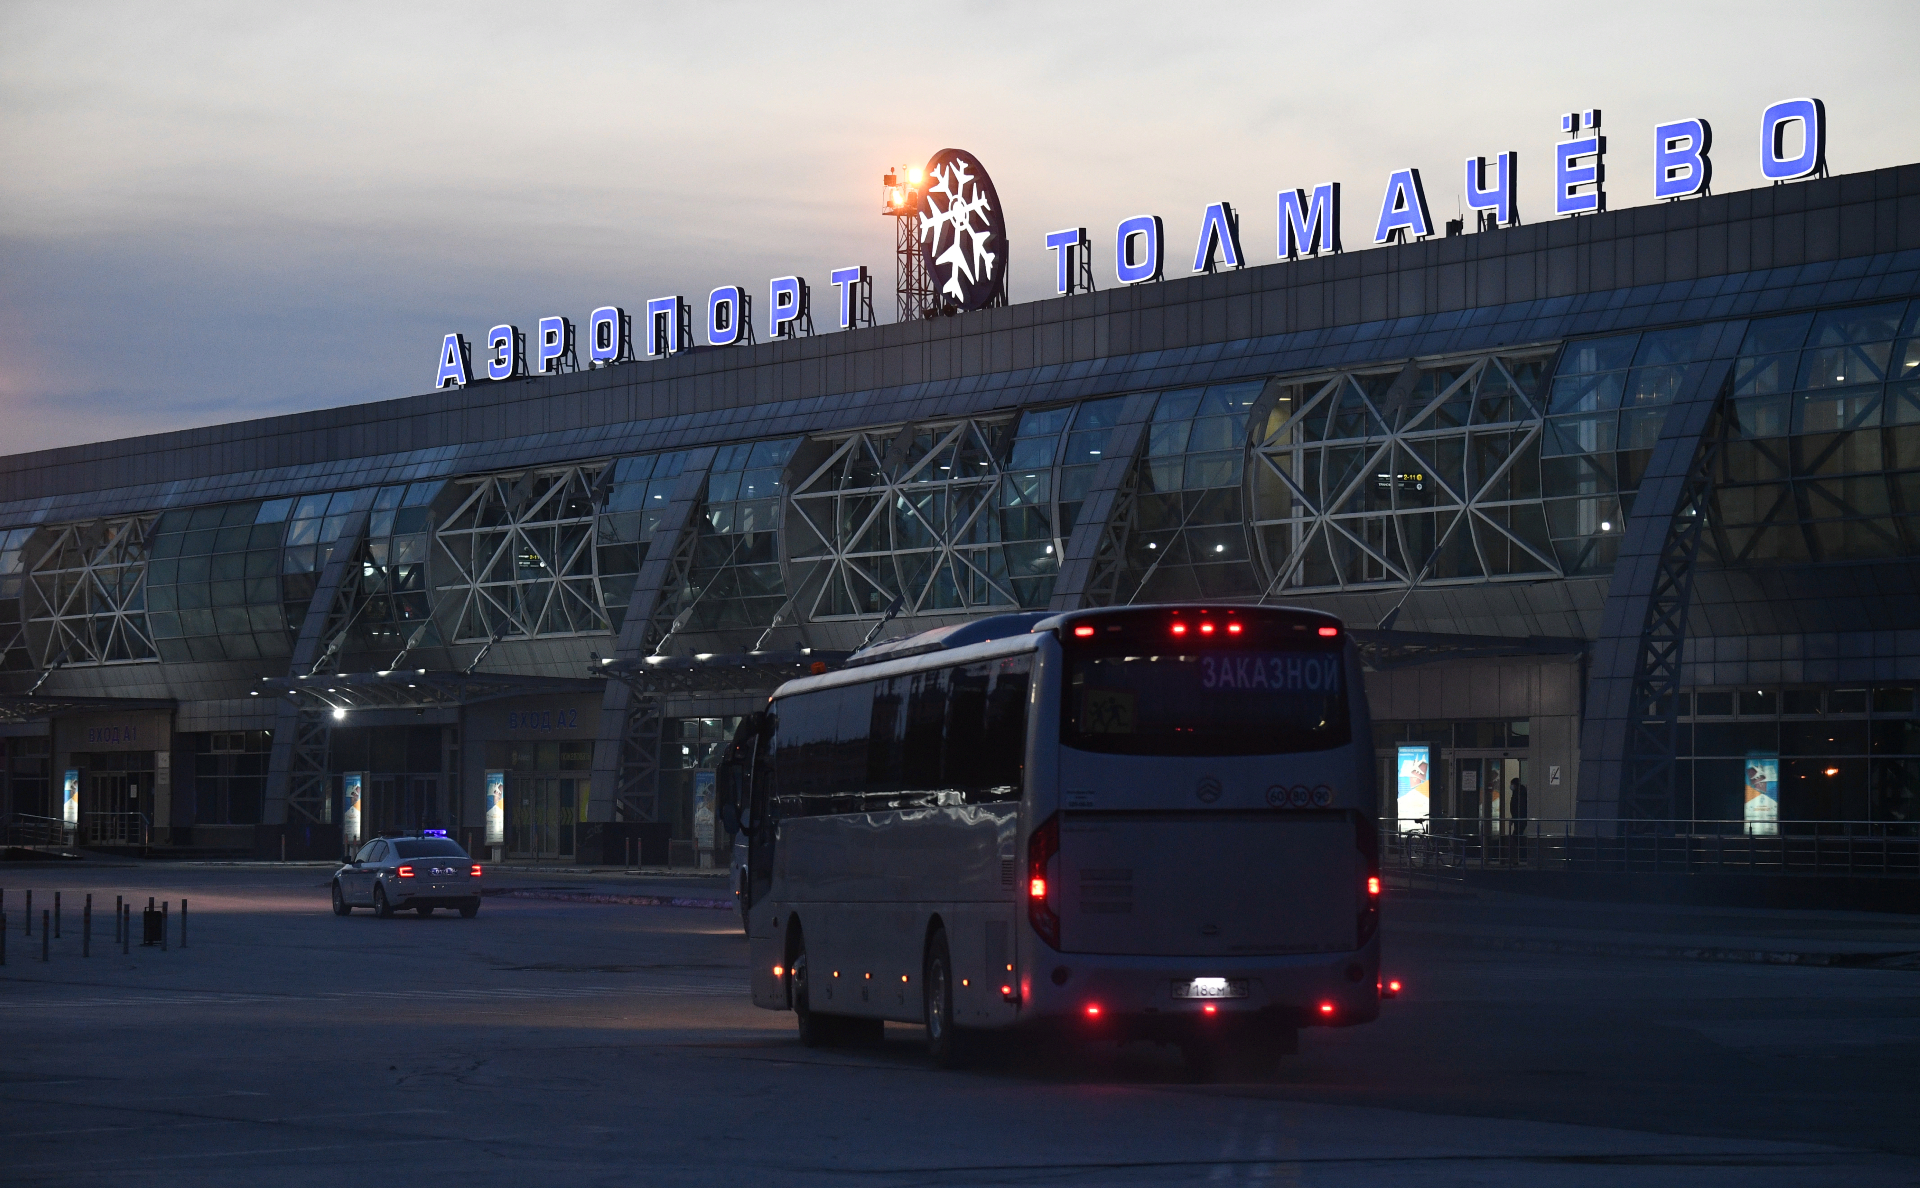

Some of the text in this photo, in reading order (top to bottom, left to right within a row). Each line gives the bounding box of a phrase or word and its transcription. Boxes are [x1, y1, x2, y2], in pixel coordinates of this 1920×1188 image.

[435, 97, 1826, 389] АЭРОПОРТ ТОЛМАЧЁВО
[1202, 653, 1339, 692] ЗАКАЗНОЙ
[509, 708, 578, 733] ВХОД А2
[89, 726, 137, 744] ВХОД А1
[1270, 790, 1284, 802] 60
[1293, 790, 1307, 802] 80
[1315, 790, 1330, 802] 90
